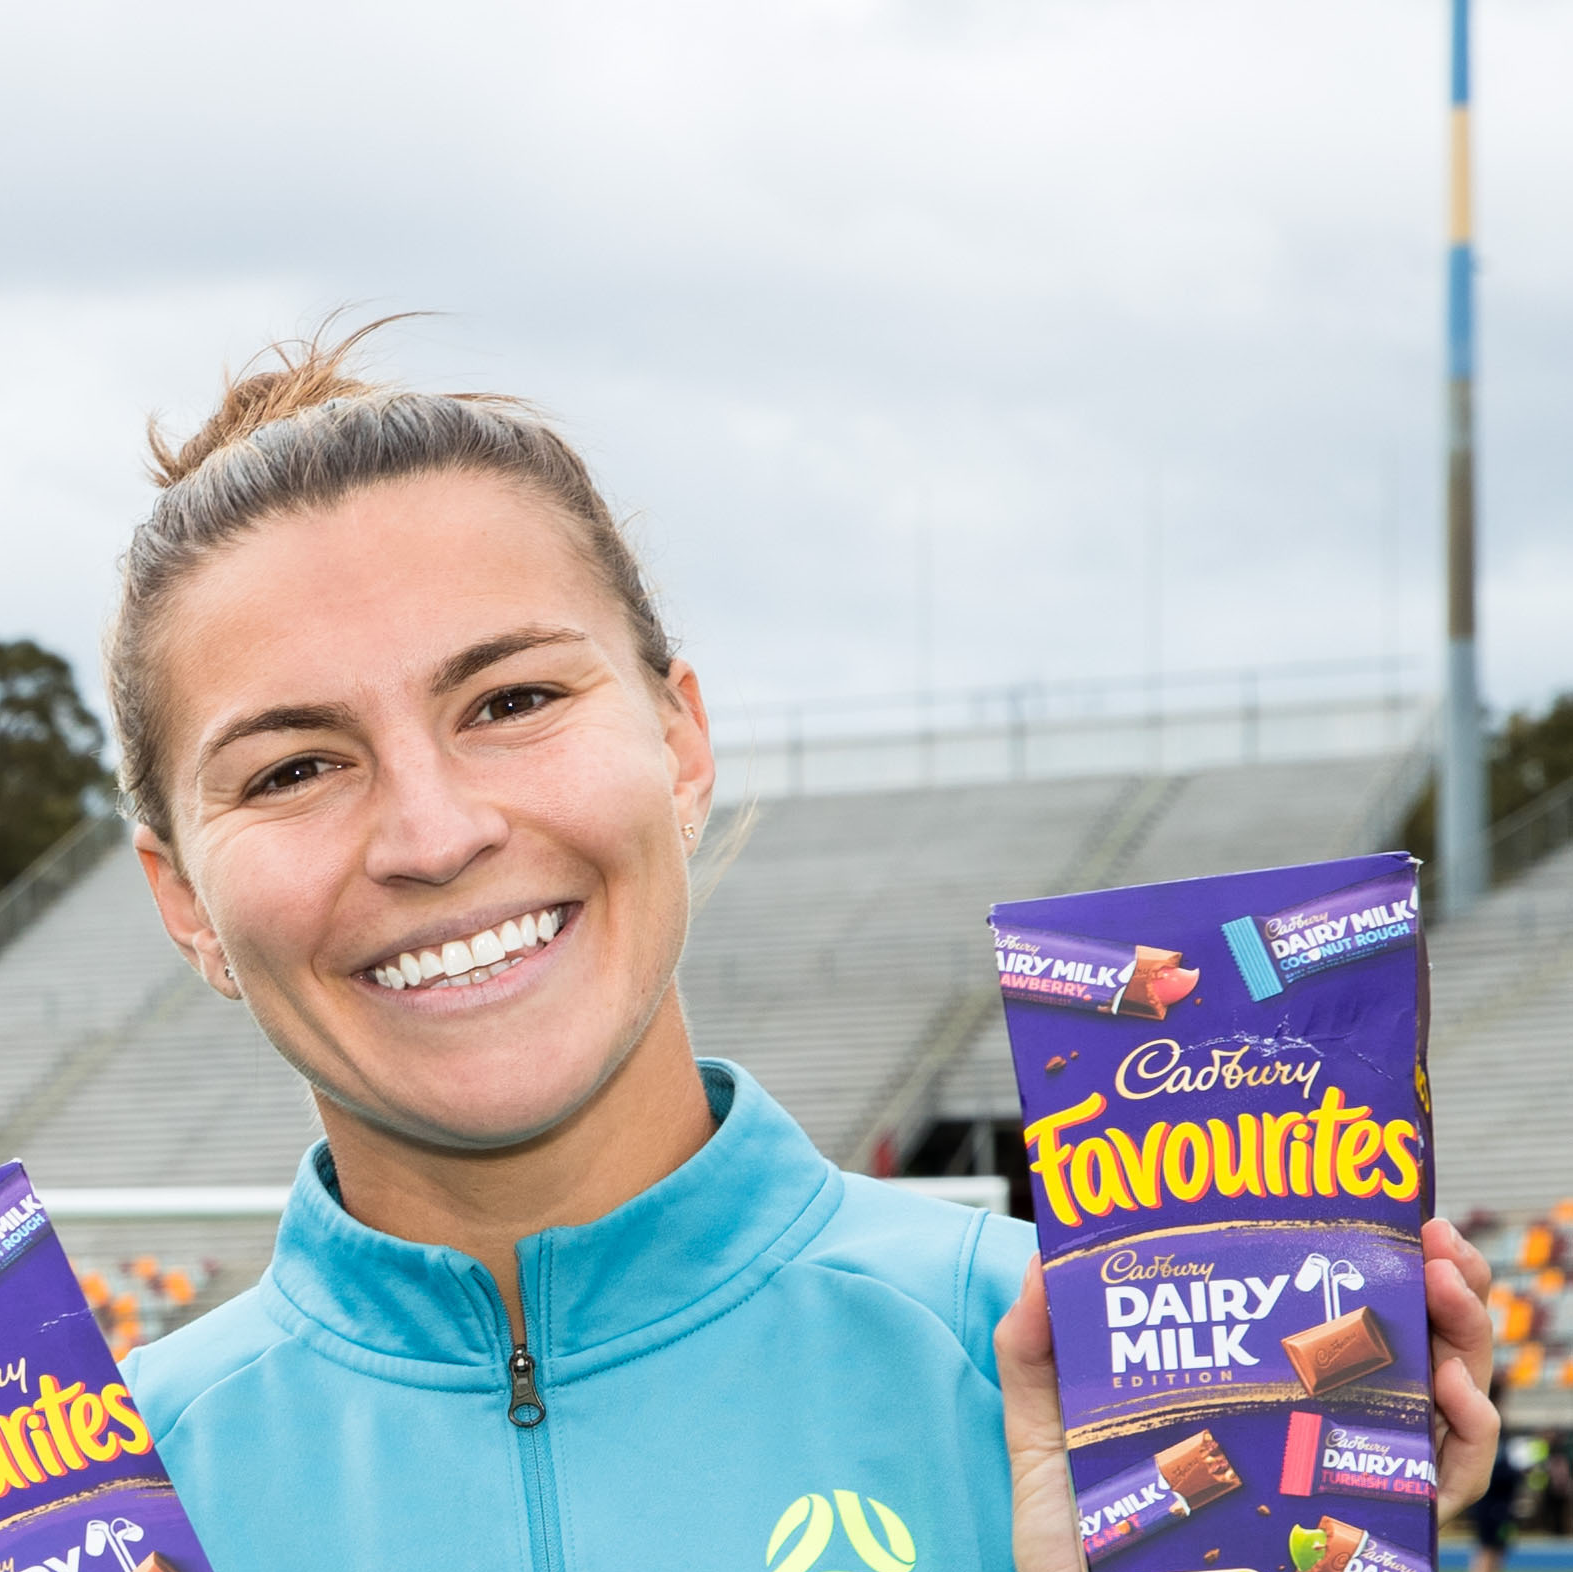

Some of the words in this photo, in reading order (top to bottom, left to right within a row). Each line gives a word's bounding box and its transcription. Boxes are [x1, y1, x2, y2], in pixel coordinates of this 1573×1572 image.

[1265, 911, 1329, 940] Cadbury
[1271, 916, 1348, 959] DAIRY
[1349, 899, 1416, 934] MILK
[1354, 922, 1411, 947] ROUGH
[1051, 959, 1118, 988] MILK
[1115, 1035, 1323, 1101] Cadbury
[1024, 1086, 1421, 1228] Favourites
[0, 1212, 46, 1252] ROUGH
[1100, 1250, 1215, 1283] Cadbury
[1105, 1274, 1291, 1328] DAIRY
[1111, 1323, 1260, 1374] MILK
[1112, 1370, 1233, 1389] EDITION
[1325, 1428, 1390, 1455] Cadbury
[1323, 1449, 1404, 1477] DAIRY
[1104, 1481, 1167, 1524] MILK
